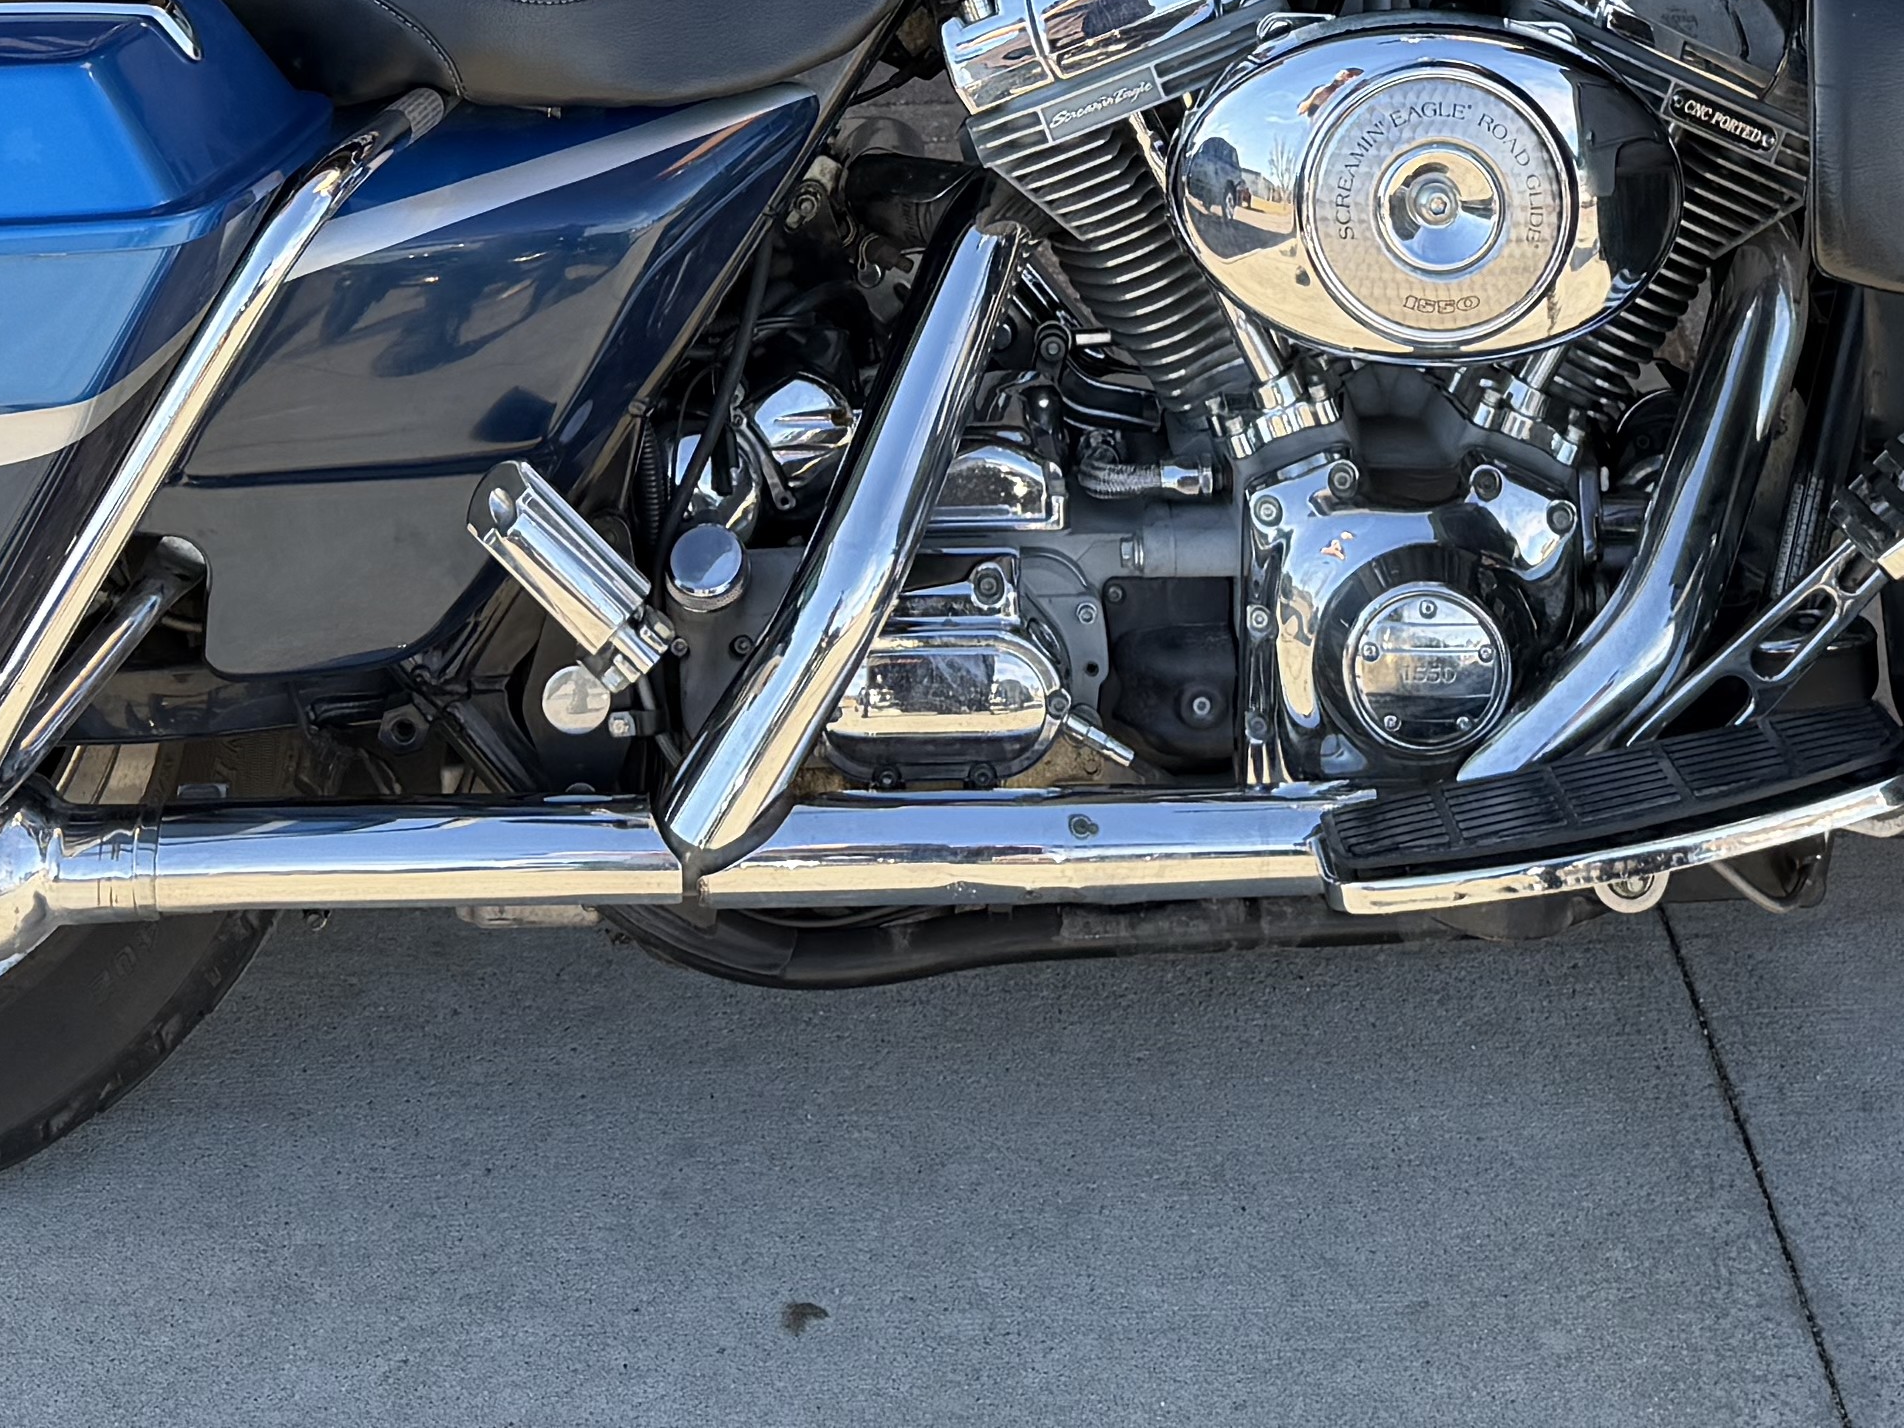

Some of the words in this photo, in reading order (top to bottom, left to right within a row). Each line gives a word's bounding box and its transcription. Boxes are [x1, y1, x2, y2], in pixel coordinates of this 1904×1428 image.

[1477, 113, 1531, 168] ROAD
[1684, 99, 1713, 121] CNC
[1710, 111, 1762, 143] PORTED
[1402, 294, 1481, 315] 1550
